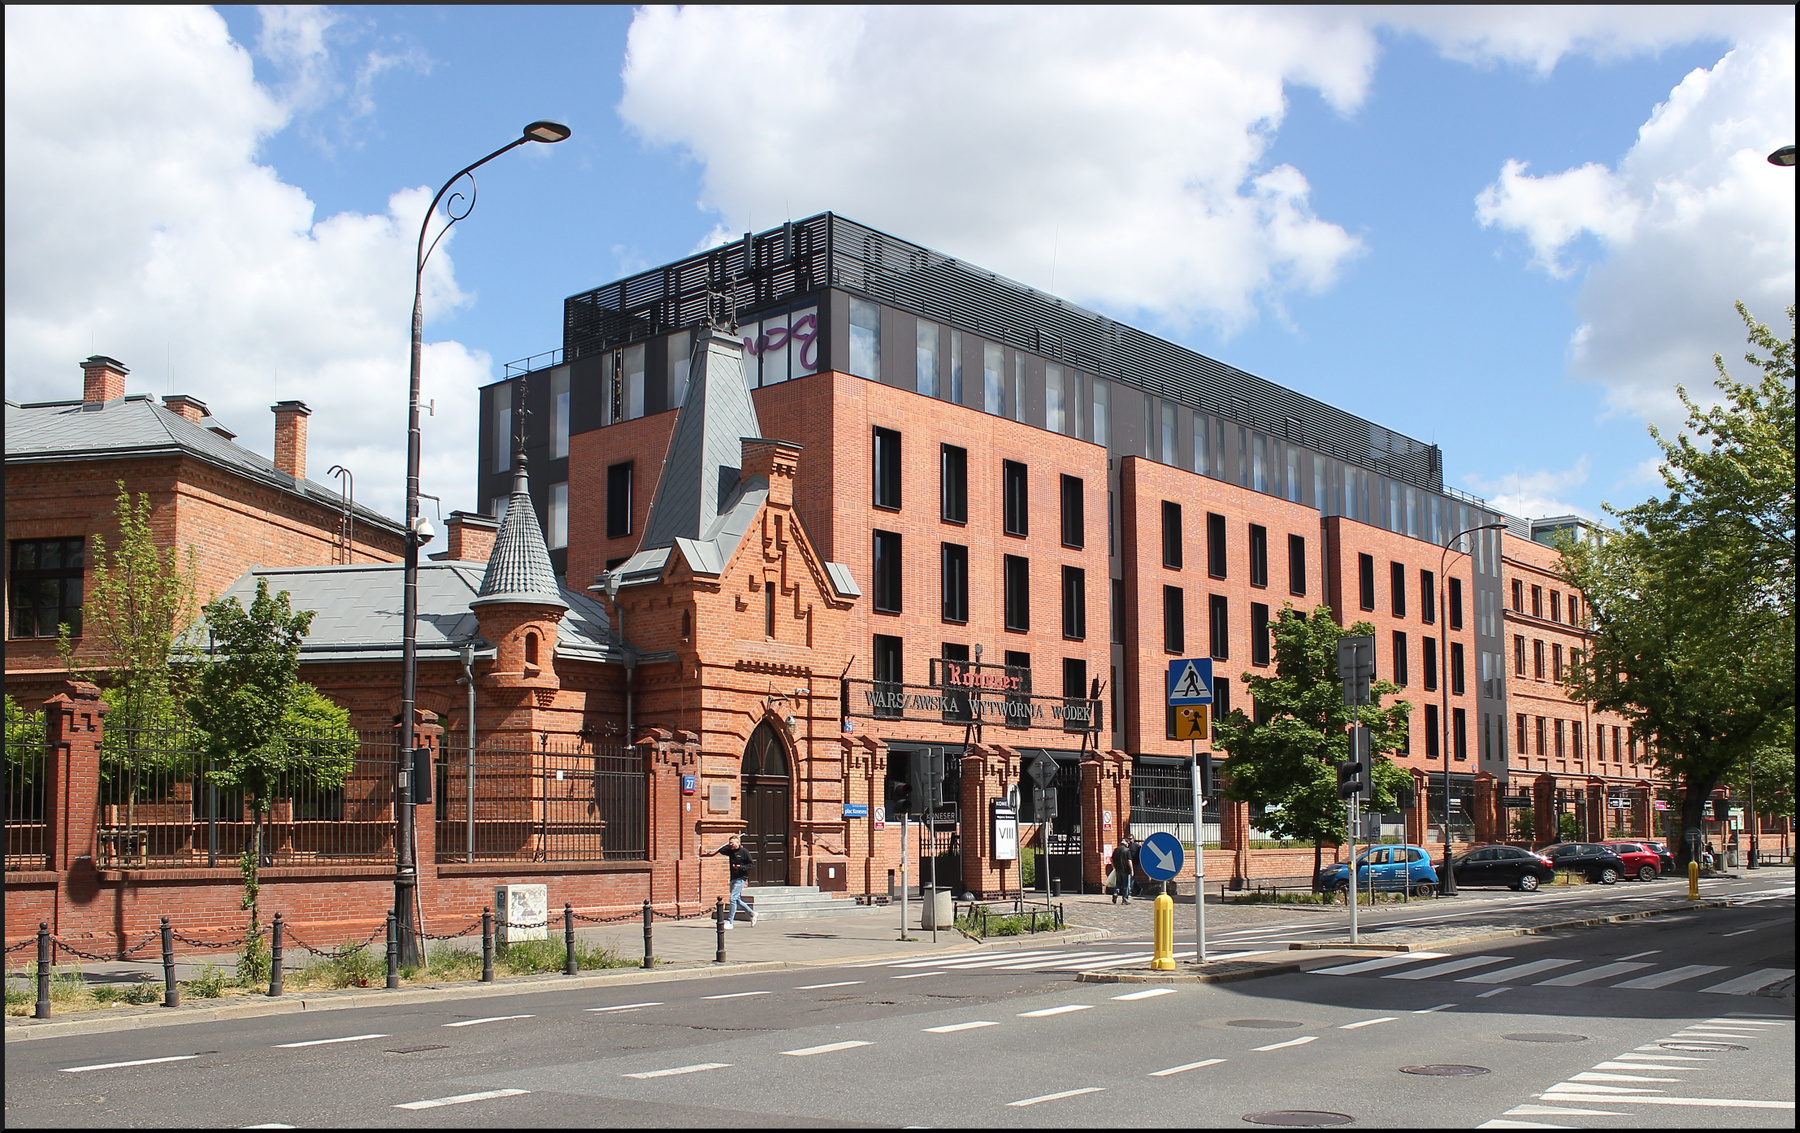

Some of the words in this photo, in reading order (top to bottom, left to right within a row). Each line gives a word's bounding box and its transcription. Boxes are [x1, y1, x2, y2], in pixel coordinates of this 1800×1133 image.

[865, 690, 960, 713] WARSZAWSKA
[967, 698, 1044, 719] WYTWÓRNIA
[1051, 704, 1092, 722] WÓDEK
[686, 780, 694, 789] 27
[926, 812, 955, 820] KNESER
[998, 827, 1014, 839] VIII
